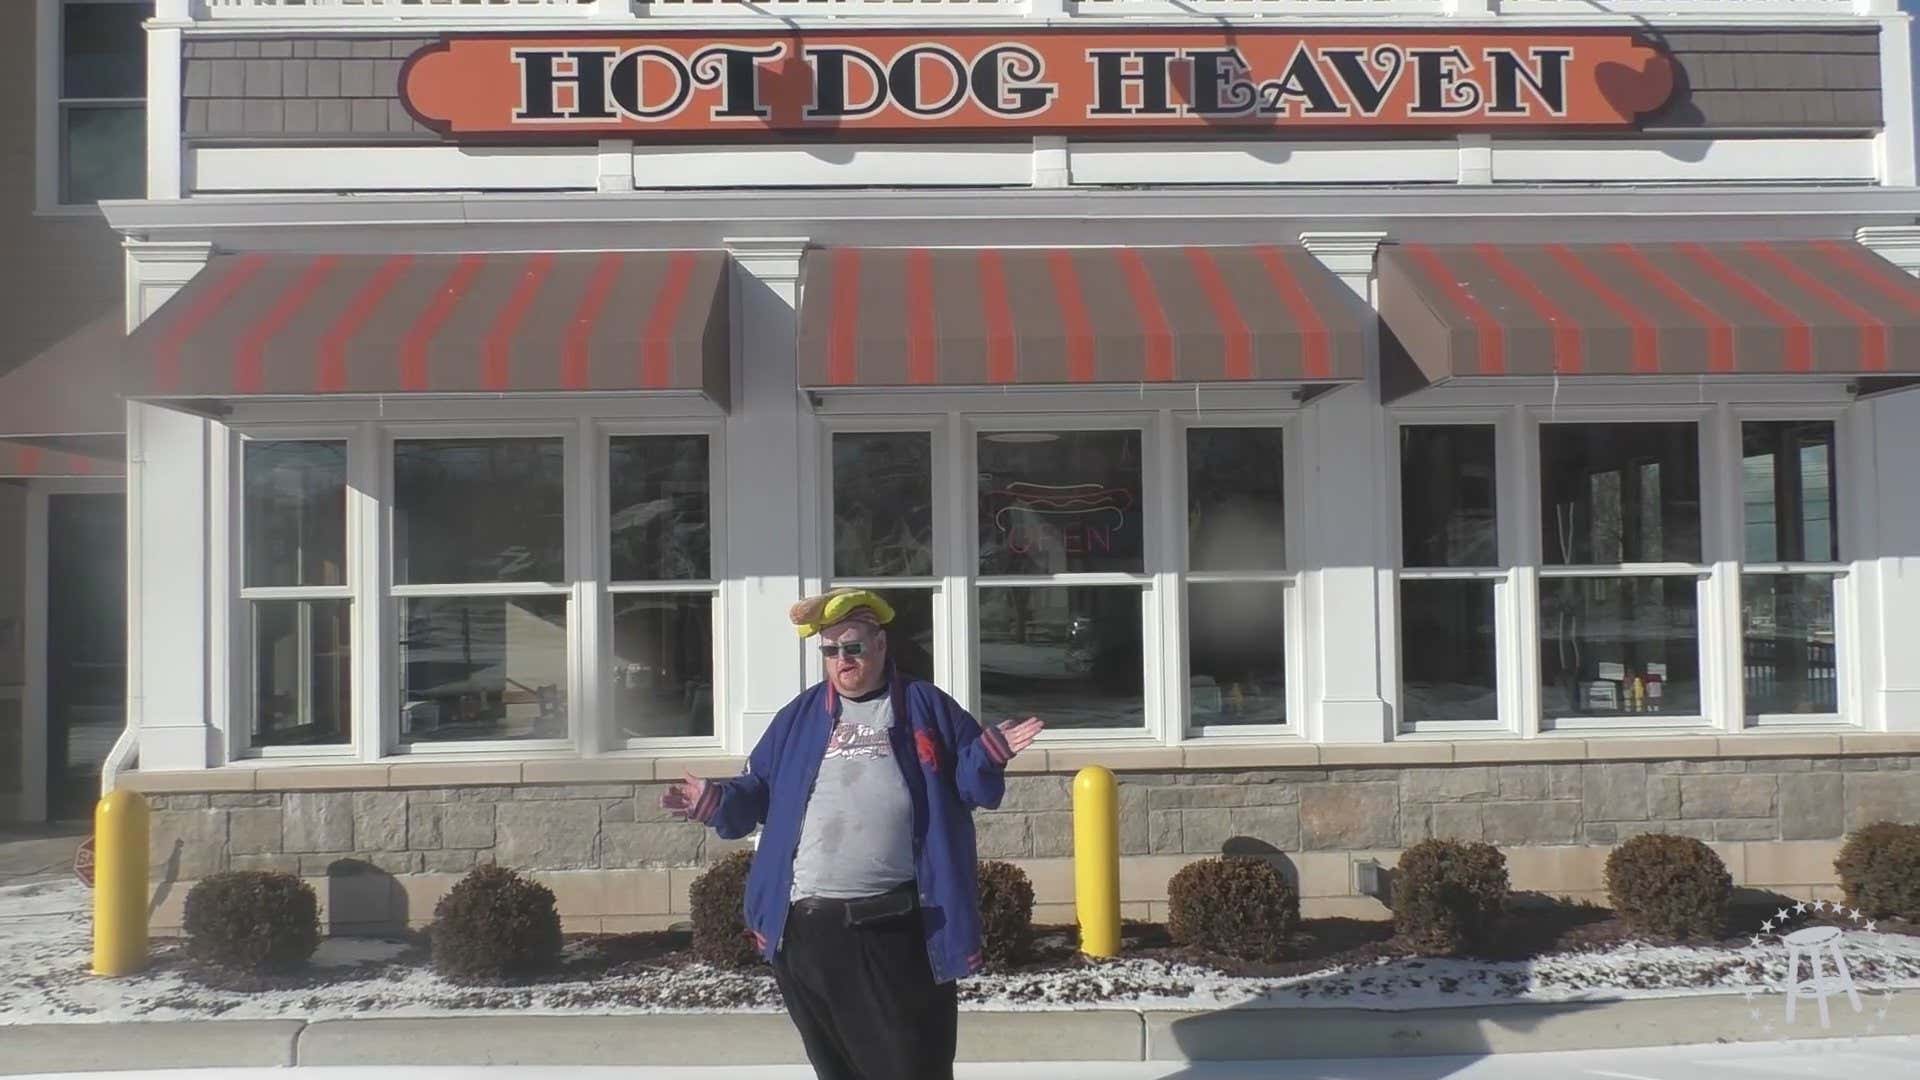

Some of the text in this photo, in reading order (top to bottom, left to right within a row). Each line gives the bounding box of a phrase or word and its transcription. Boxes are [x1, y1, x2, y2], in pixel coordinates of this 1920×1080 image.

[511, 40, 1575, 123] HOT DOG HEAVEN
[1008, 524, 1112, 554] OPEN
